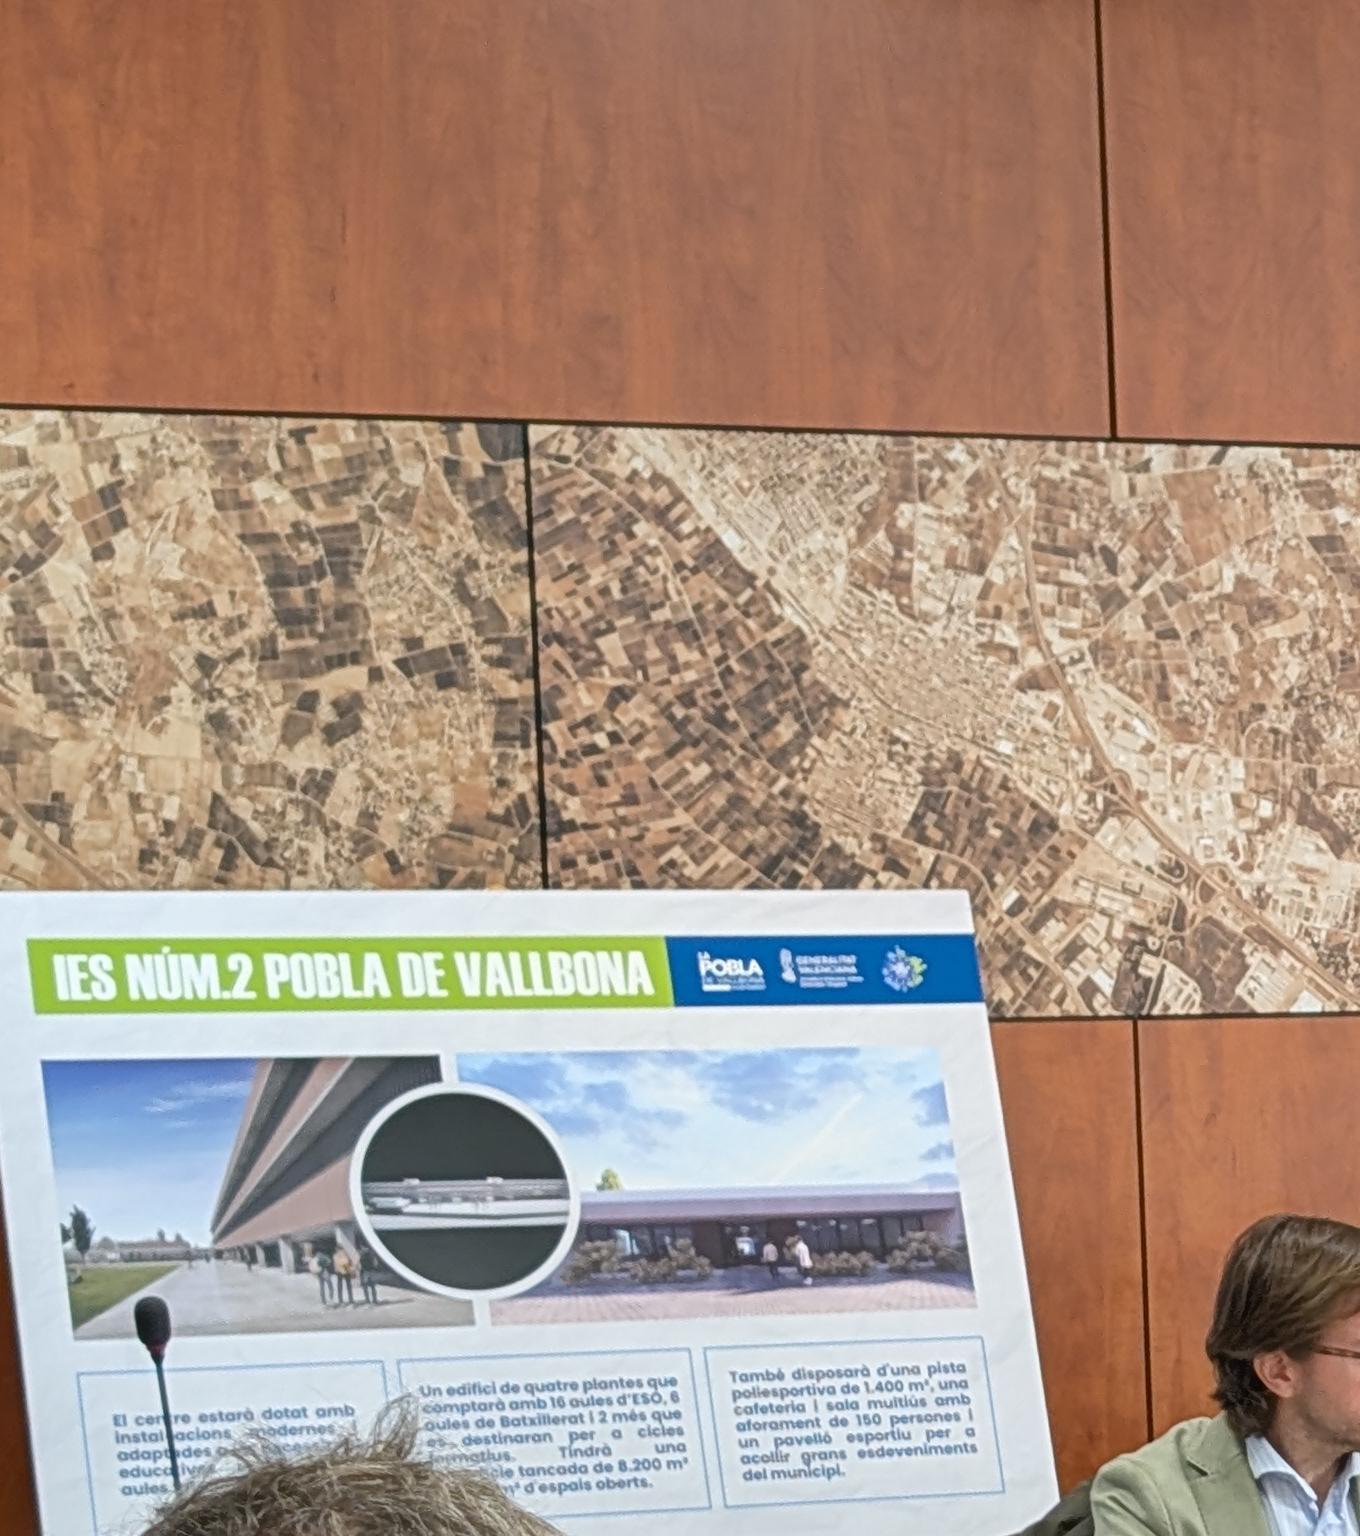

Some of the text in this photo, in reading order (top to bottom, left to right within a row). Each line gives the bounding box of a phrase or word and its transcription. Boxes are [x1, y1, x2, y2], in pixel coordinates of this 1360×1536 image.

[52, 945, 655, 1001] IES NÚM.2 POBLA DE VALLBONA
[699, 958, 764, 977] POBLA
[729, 1361, 966, 1383] També disposarà d'una pista
[420, 1376, 678, 1398] Un edifici de quatre plantes que
[732, 1383, 836, 1403] poliesportiva
[840, 1382, 860, 1394] de
[864, 1380, 904, 1394] 1.400
[939, 1379, 969, 1391] una
[423, 1398, 505, 1415] comptarà
[509, 1396, 547, 1411] amb
[550, 1394, 566, 1408] 16
[569, 1392, 614, 1407] aules
[670, 1390, 680, 1404] 6
[734, 1400, 806, 1416] cafeteria
[826, 1398, 859, 1411] sala
[867, 1395, 927, 1410] multiús
[935, 1393, 971, 1406] amb
[112, 1403, 355, 1427] El cenre estarà dotat amb
[424, 1417, 470, 1432] aules
[475, 1416, 495, 1429] de
[501, 1411, 584, 1428] Batxillerat
[599, 1410, 607, 1424] 2
[612, 1408, 647, 1423] més
[651, 1409, 682, 1426] que
[736, 1416, 821, 1432] aforament
[829, 1415, 848, 1427] de
[856, 1413, 881, 1426] 150
[890, 1411, 961, 1428] persones
[462, 1431, 553, 1448] destinaran
[569, 1430, 595, 1444] per
[611, 1429, 622, 1440] a
[638, 1424, 684, 1438] cicles
[738, 1427, 975, 1450] un pavelló esportiu per a
[559, 1442, 612, 1459] Tindrà
[655, 1442, 686, 1454] una
[740, 1442, 978, 1467] acollir grans esdeveniments
[518, 1462, 589, 1478] tancada
[593, 1461, 613, 1474] de
[618, 1457, 662, 1473] 8.200
[743, 1463, 845, 1482] del municipi.
[121, 1482, 168, 1496] aules
[524, 1478, 592, 1496] d'espais
[596, 1476, 653, 1492] oberts.
